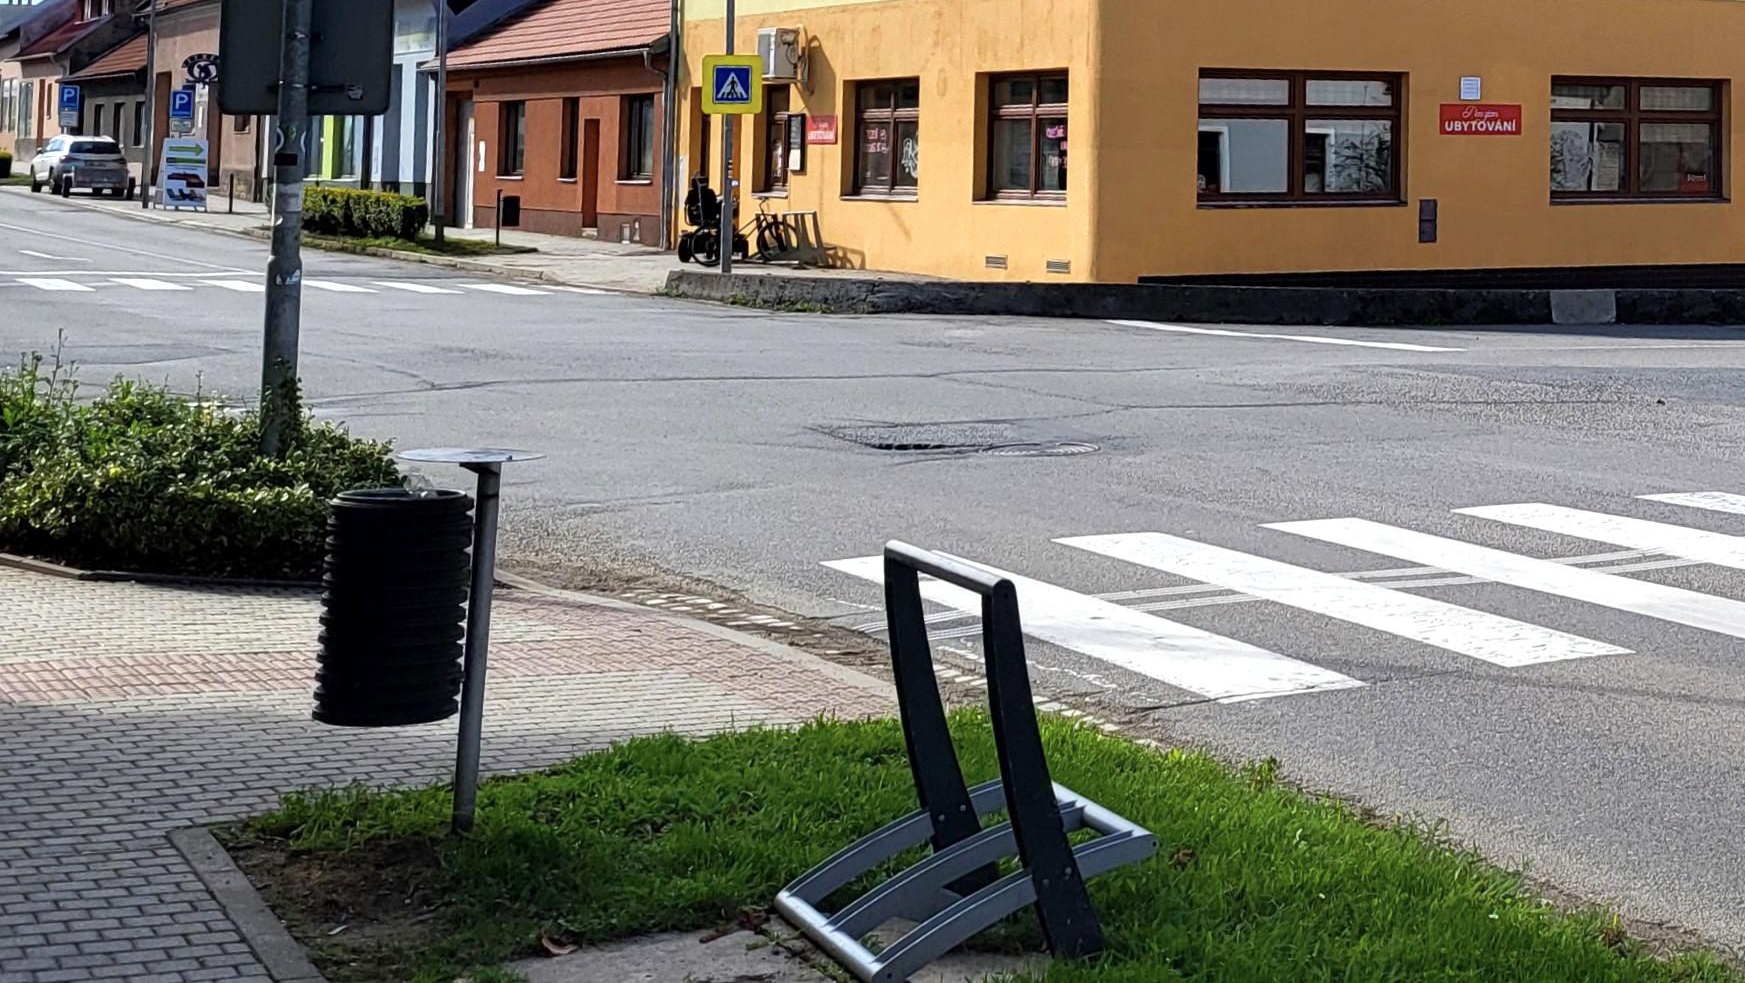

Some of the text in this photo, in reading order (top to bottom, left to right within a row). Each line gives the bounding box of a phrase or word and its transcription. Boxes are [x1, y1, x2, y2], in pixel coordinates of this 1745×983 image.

[63, 89, 75, 102] P
[174, 93, 189, 110] P
[1445, 119, 1517, 132] UBYTOVÁNÍ
